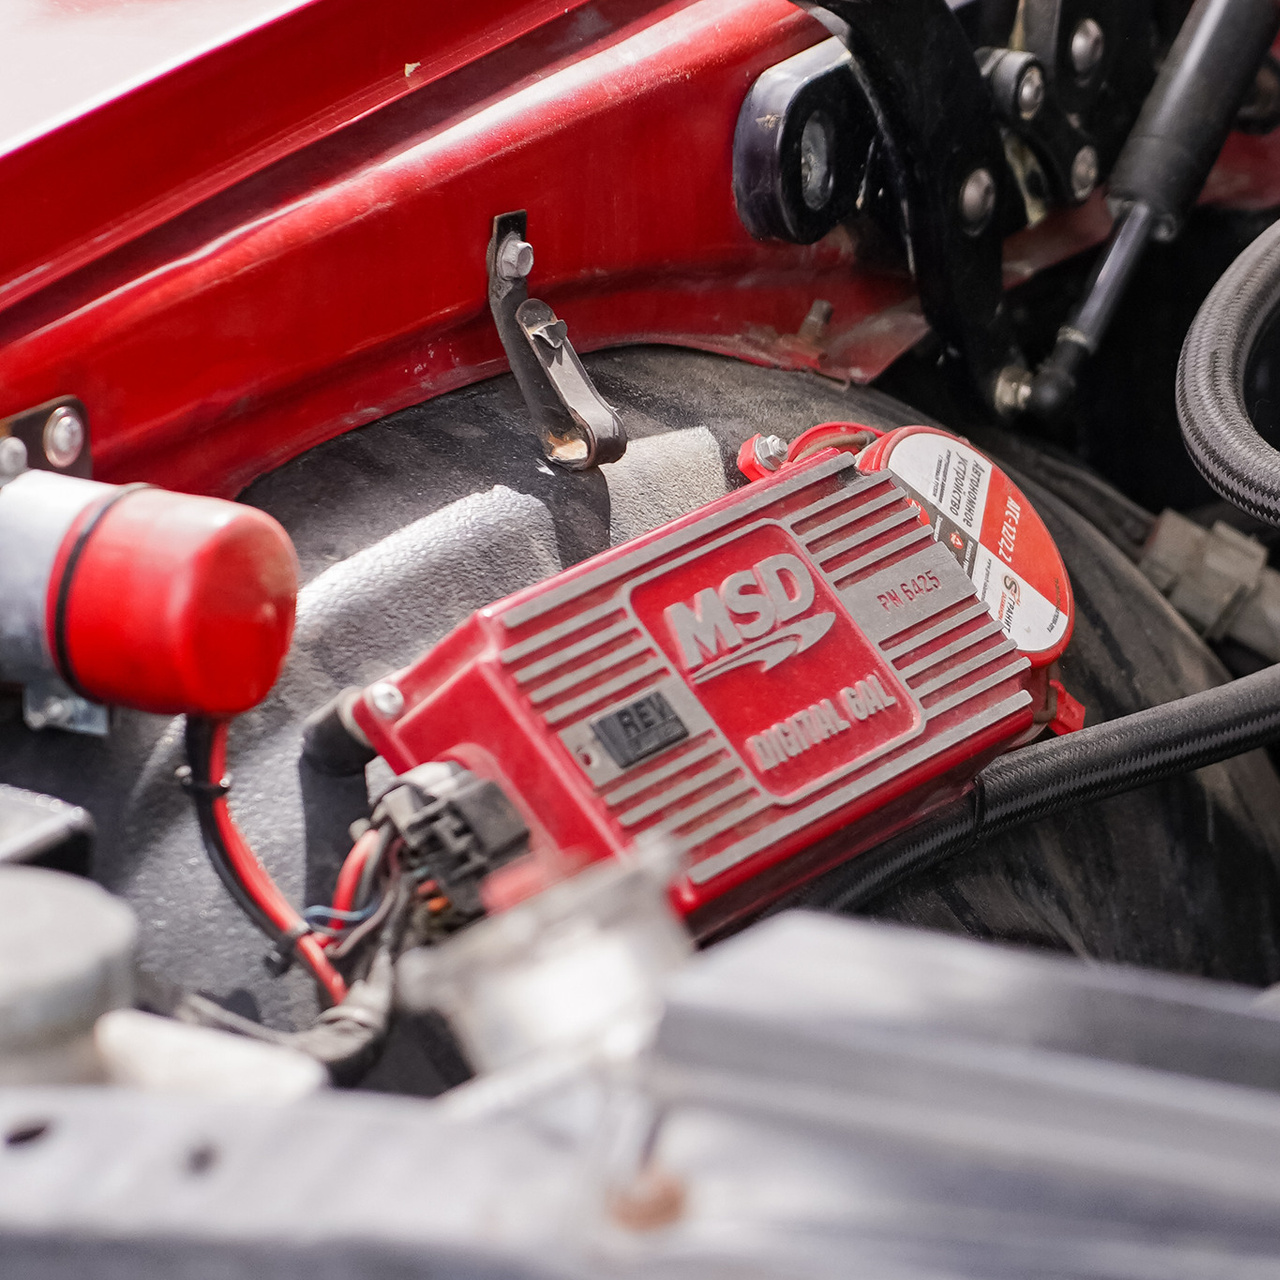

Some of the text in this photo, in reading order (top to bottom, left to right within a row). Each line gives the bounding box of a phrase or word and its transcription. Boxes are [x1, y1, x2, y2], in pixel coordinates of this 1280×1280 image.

[949, 453, 969, 516] устройство
[963, 460, 985, 528] Автономное
[998, 496, 1021, 562] АГС-12/2,2
[664, 554, 814, 668] MSD
[877, 570, 941, 611] PN 6425
[1004, 597, 1016, 633] ГРАНИТ
[617, 692, 667, 738] REV
[745, 674, 897, 771] DIGITAL 6AL
